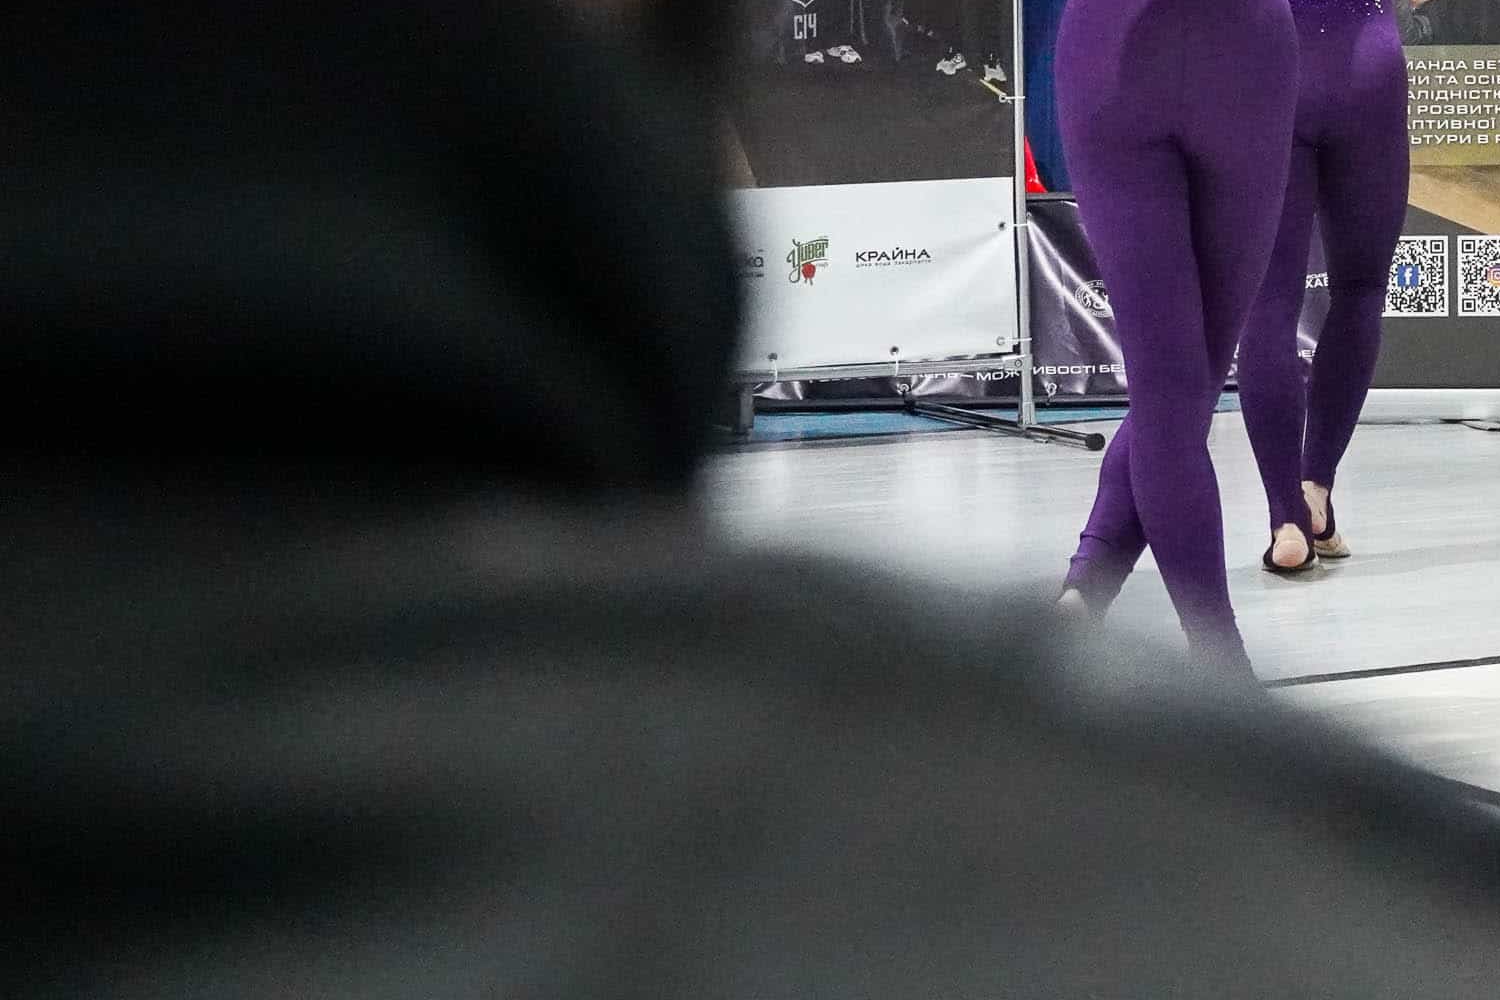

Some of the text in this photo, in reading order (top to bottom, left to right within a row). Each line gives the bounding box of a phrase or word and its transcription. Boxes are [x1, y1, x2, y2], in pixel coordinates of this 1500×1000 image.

[793, 12, 817, 40] СІЧ
[1435, 75, 1458, 85] ТА
[1411, 134, 1472, 145] ЬТУРИ
[1477, 134, 1489, 145] В
[855, 246, 932, 264] КРАЙНА
[976, 365, 1096, 382] МОЖИВОСТІ
